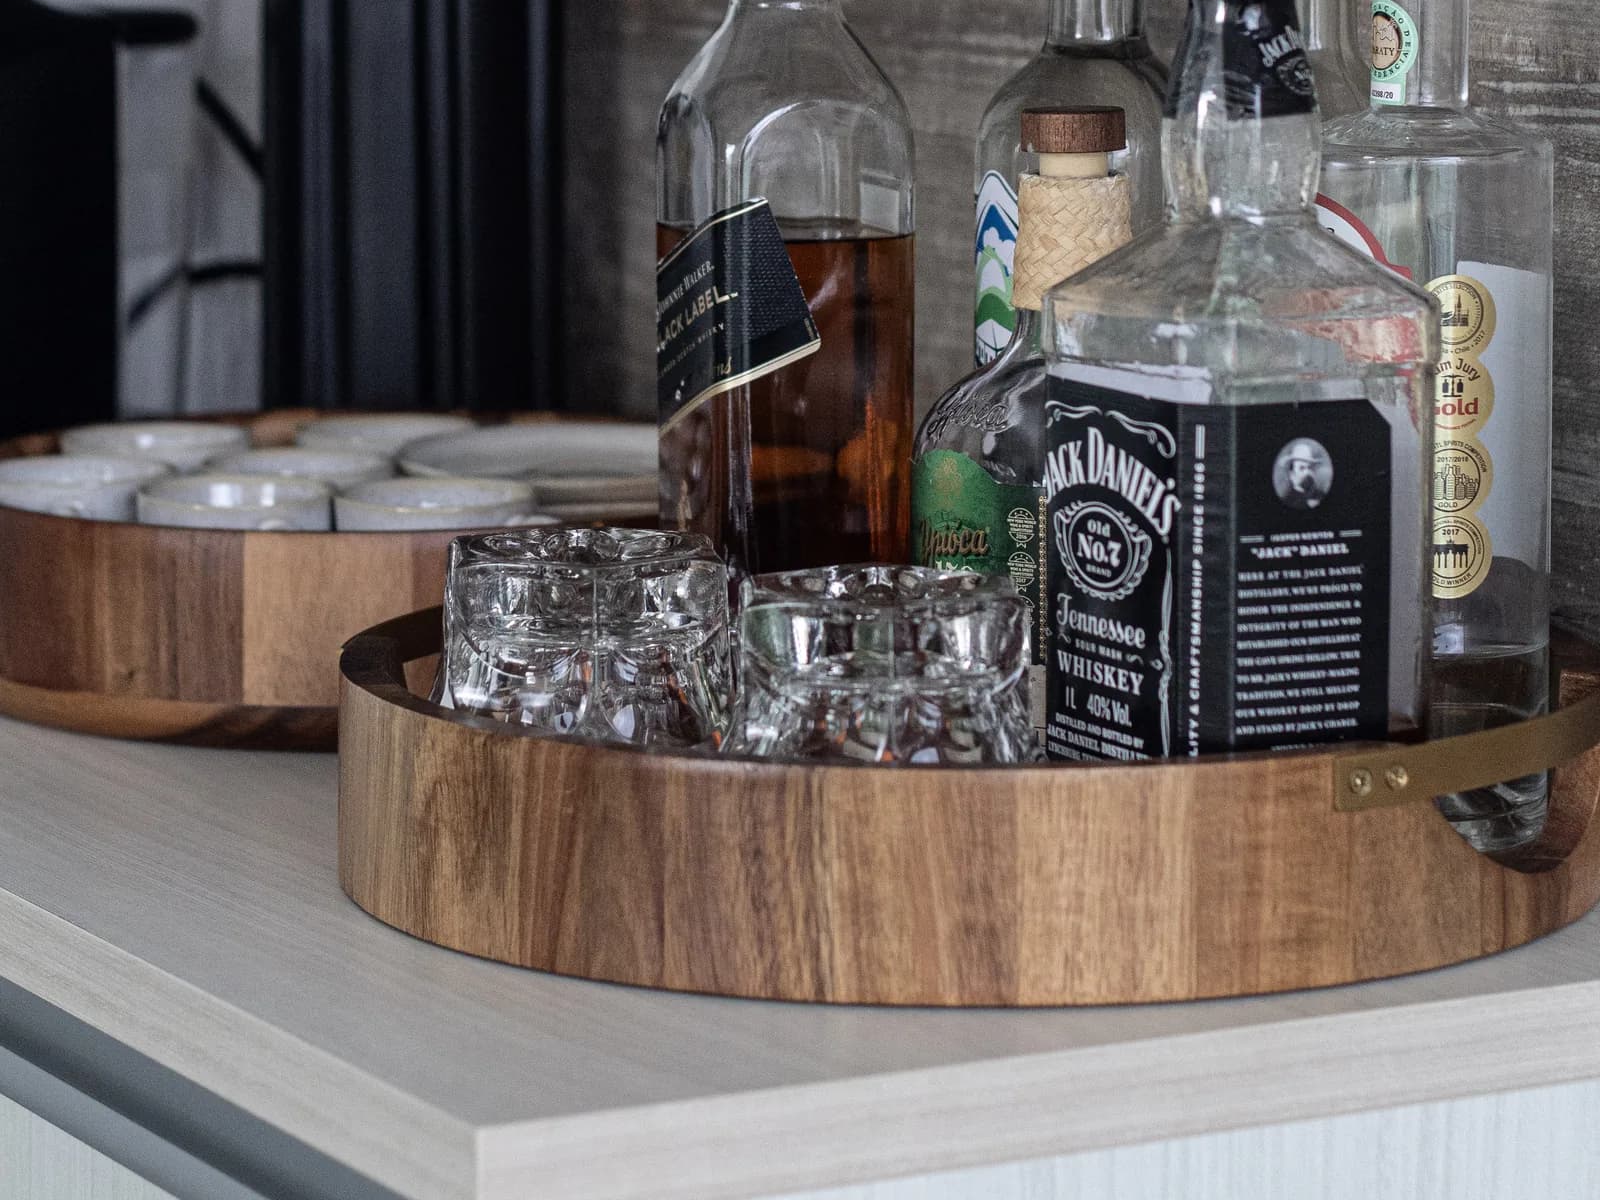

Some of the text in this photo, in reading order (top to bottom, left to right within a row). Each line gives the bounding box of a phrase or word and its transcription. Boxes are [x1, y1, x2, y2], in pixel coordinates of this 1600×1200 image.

[1456, 357, 1481, 382] Jury
[1087, 519, 1111, 538] Old
[1191, 504, 1204, 555] SINCE
[1441, 528, 1460, 536] 2017
[1299, 543, 1349, 557] DANIEL
[1056, 593, 1146, 649] Tennessee
[1189, 558, 1203, 700] CRAFTSMANSHIP
[1056, 649, 1144, 697] WHISKEY
[1086, 693, 1112, 721] 40%
